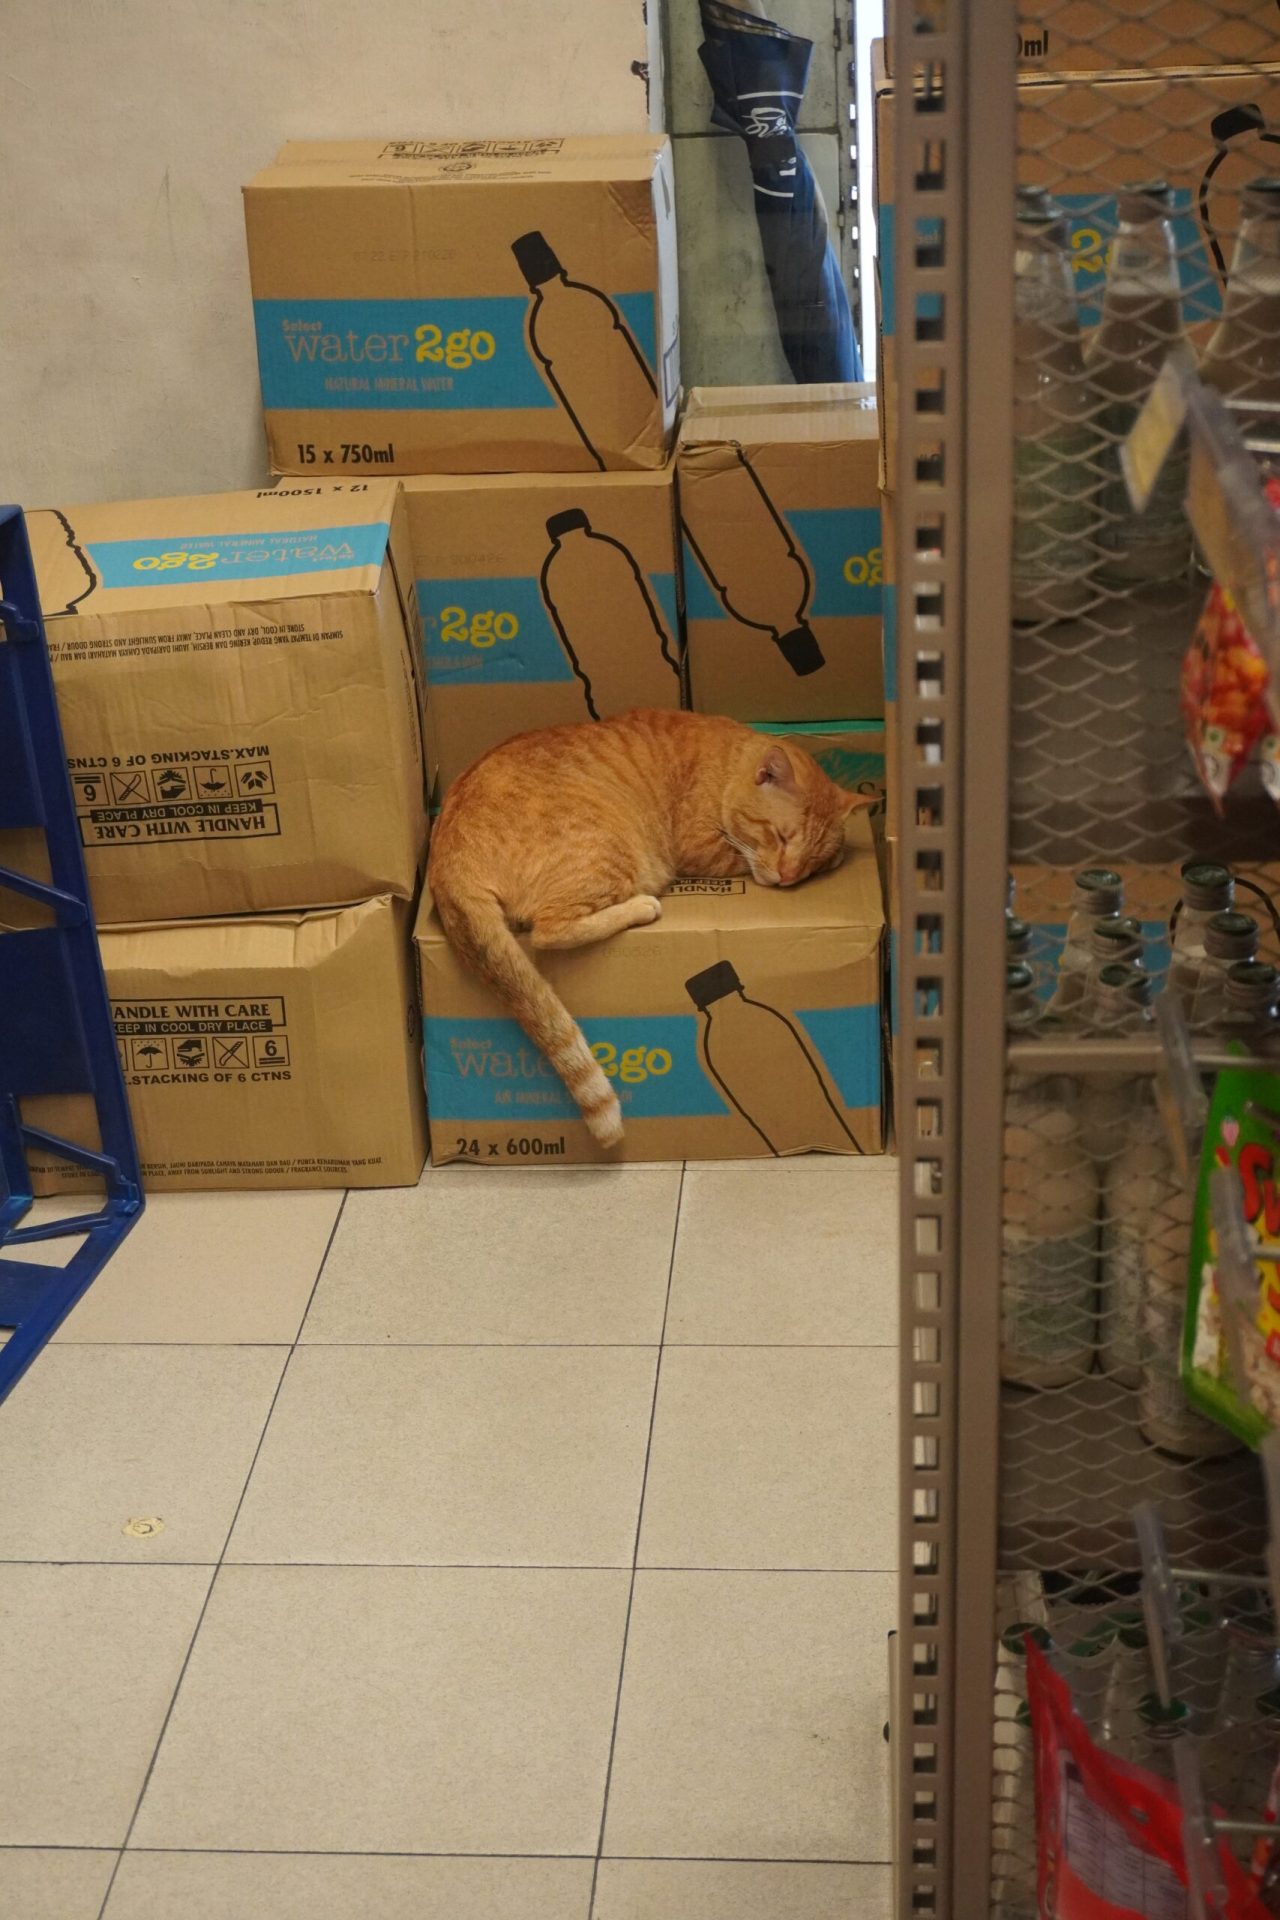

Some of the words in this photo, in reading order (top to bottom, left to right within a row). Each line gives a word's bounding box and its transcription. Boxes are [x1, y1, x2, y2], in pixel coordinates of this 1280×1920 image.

[415, 324, 496, 369] 2go
[325, 376, 369, 391] NATURAL
[374, 376, 417, 391] MINERAL
[421, 376, 454, 391] WATER
[297, 444, 316, 464] 15
[323, 450, 334, 464] x
[340, 443, 394, 464] 750ml
[256, 487, 322, 499] 1500ml
[350, 484, 369, 493] 12
[132, 551, 219, 571] 2go
[247, 627, 259, 637] DRY
[260, 625, 278, 636] COOL,
[279, 624, 286, 634] IN
[287, 624, 305, 634] STORE
[440, 606, 519, 648] 2go
[176, 632, 192, 643] AWAY
[193, 631, 212, 641] PLACE,
[213, 629, 232, 640] CLEAN
[233, 628, 246, 638] AND
[290, 633, 312, 643] TEMPAT
[312, 632, 320, 641] DI
[321, 630, 344, 641] SIMPAN
[89, 639, 113, 650] STRONG
[113, 638, 127, 648] AND
[127, 636, 157, 646] SUNLIGHT
[157, 634, 175, 644] FROM
[229, 638, 251, 648] KERING
[274, 635, 290, 645] YANG
[67, 641, 88, 651] ODOUR
[141, 645, 171, 655] DARIPADA
[172, 644, 189, 653] JAUHI
[215, 640, 228, 650] DAN
[74, 651, 87, 661] DAN
[87, 649, 117, 660] MATAHARI
[118, 647, 141, 657] CAHAYA
[60, 653, 73, 663] BAU
[150, 744, 270, 764] MAX.STACKING
[67, 756, 108, 769] CTNS
[111, 756, 121, 768] 6
[126, 753, 146, 767] OF
[140, 807, 166, 820] DRY
[168, 804, 204, 818] COOL
[206, 803, 221, 816] IN
[224, 801, 257, 815] KEEP
[95, 809, 137, 823] PLACE
[145, 820, 191, 837] WITH
[195, 816, 266, 833] HANDLE
[94, 823, 141, 840] CARE
[113, 1005, 171, 1019] ANDLE
[174, 1004, 220, 1018] WITH
[224, 1003, 271, 1018] CARE
[145, 1022, 158, 1033] IN
[160, 1022, 196, 1033] COOL
[198, 1021, 222, 1032] DRY
[226, 1020, 267, 1031] PLACE
[264, 1040, 278, 1056] 6
[213, 1073, 233, 1083] OF
[237, 1072, 247, 1083] 6
[250, 1070, 292, 1082] CTNS
[456, 1138, 480, 1156] 24
[488, 1143, 499, 1156] x
[506, 1135, 565, 1156] 600ml
[187, 1160, 215, 1168] DARIPADA
[351, 1158, 367, 1166] YANG
[201, 1167, 227, 1175] SUNLIGHT
[228, 1167, 241, 1175] AND
[241, 1167, 264, 1175] STRONG
